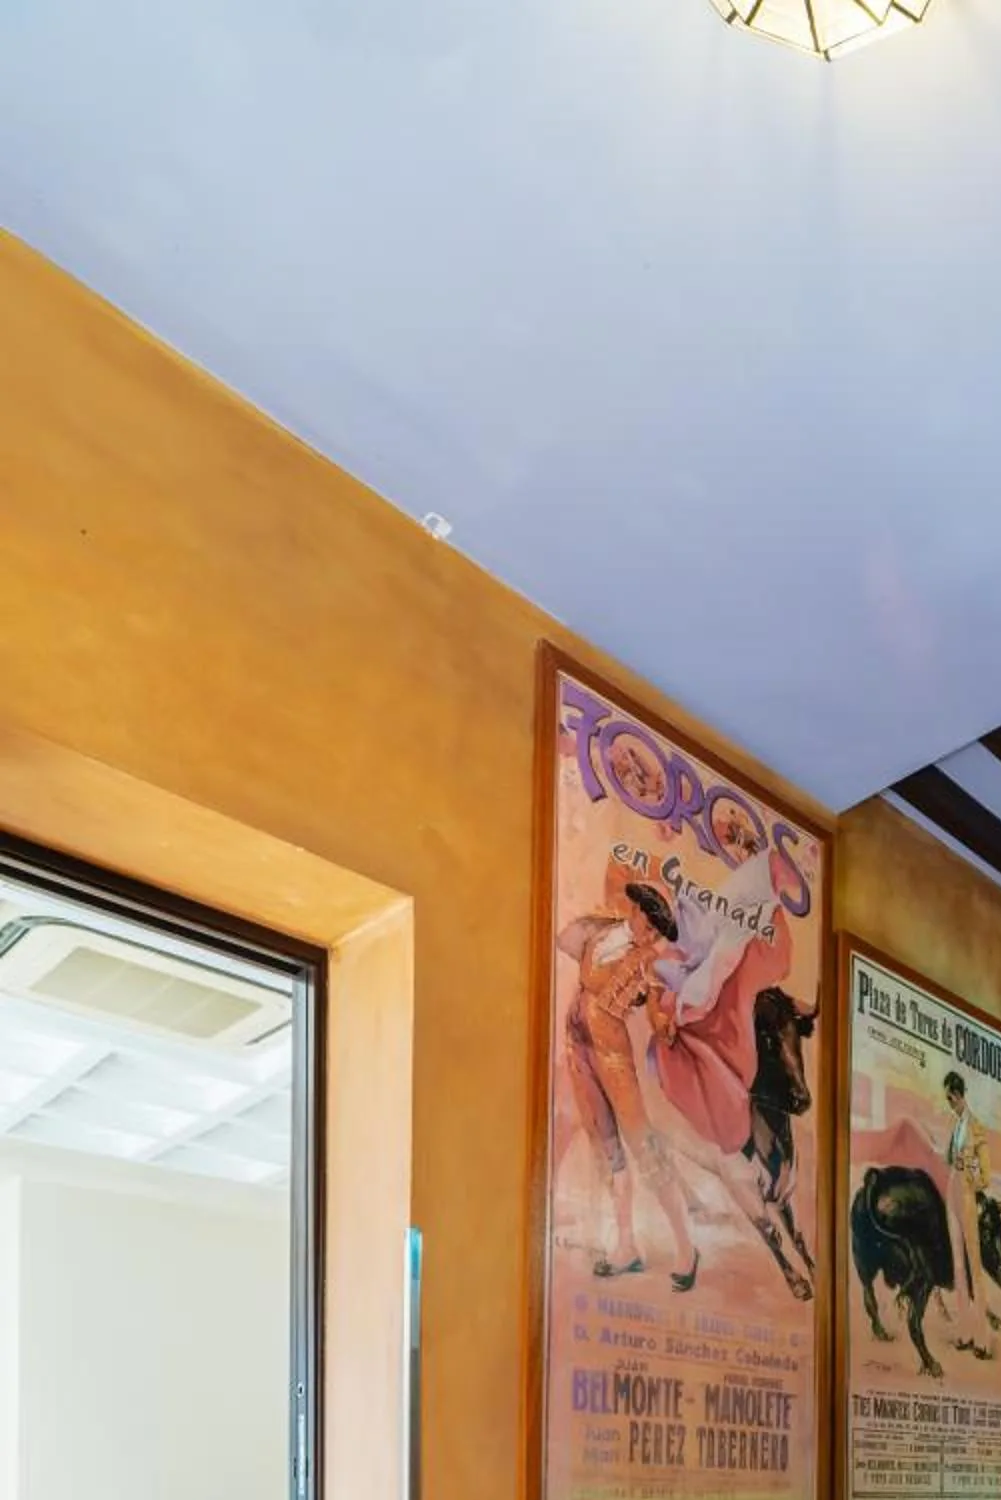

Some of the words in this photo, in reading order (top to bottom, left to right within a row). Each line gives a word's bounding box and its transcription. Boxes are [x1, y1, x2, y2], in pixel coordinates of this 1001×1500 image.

[560, 678, 811, 918] TOROS
[613, 844, 648, 873] en
[662, 856, 775, 942] Granada
[857, 970, 891, 1018] Plaza
[601, 1327, 657, 1351] Arturo
[572, 1369, 684, 1419] BELMONTE
[704, 1384, 798, 1430] MANOLETE
[628, 1420, 686, 1466] PEREZ
[696, 1424, 789, 1473] TABERNERO
